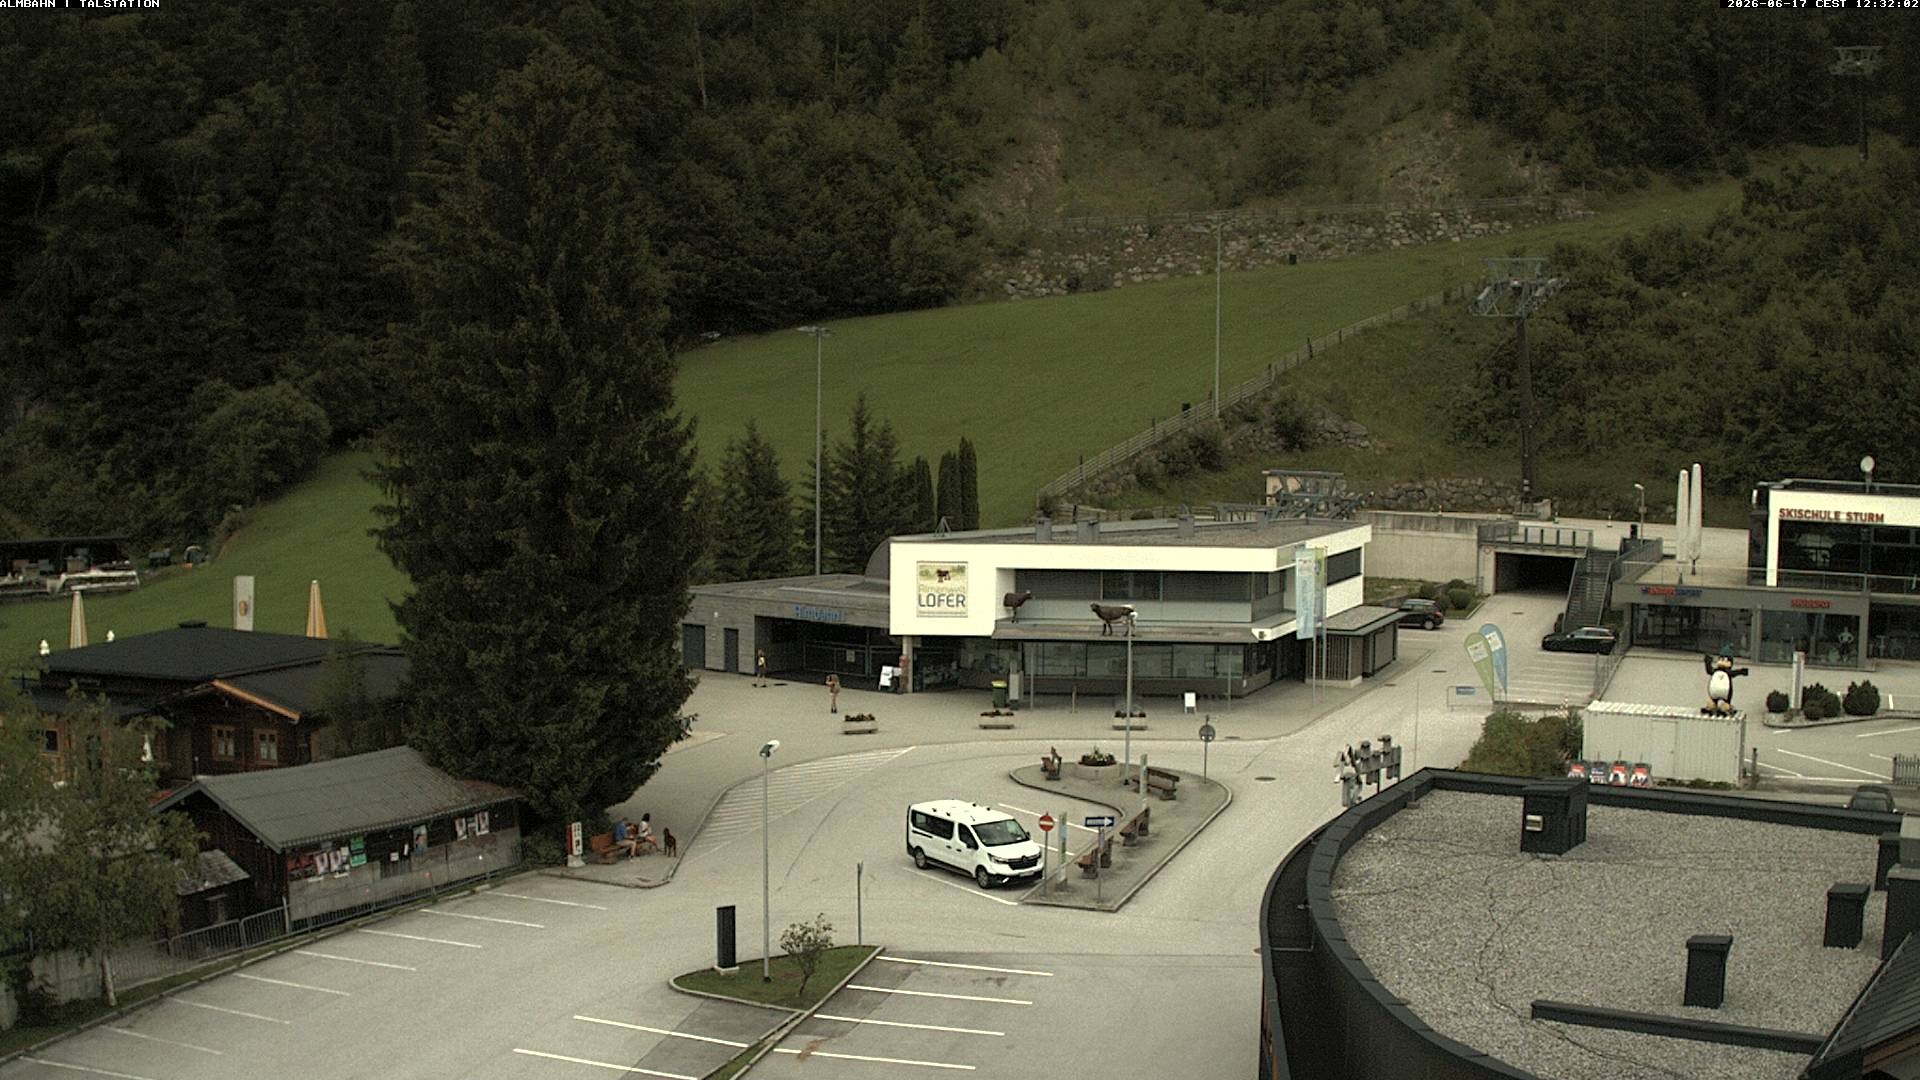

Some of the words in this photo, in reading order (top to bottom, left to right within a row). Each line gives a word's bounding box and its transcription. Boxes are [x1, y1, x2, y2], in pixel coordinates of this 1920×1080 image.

[1778, 508, 1841, 521] SKISCHULE
[1845, 511, 1885, 523] STURM
[918, 593, 966, 608] LOFER
